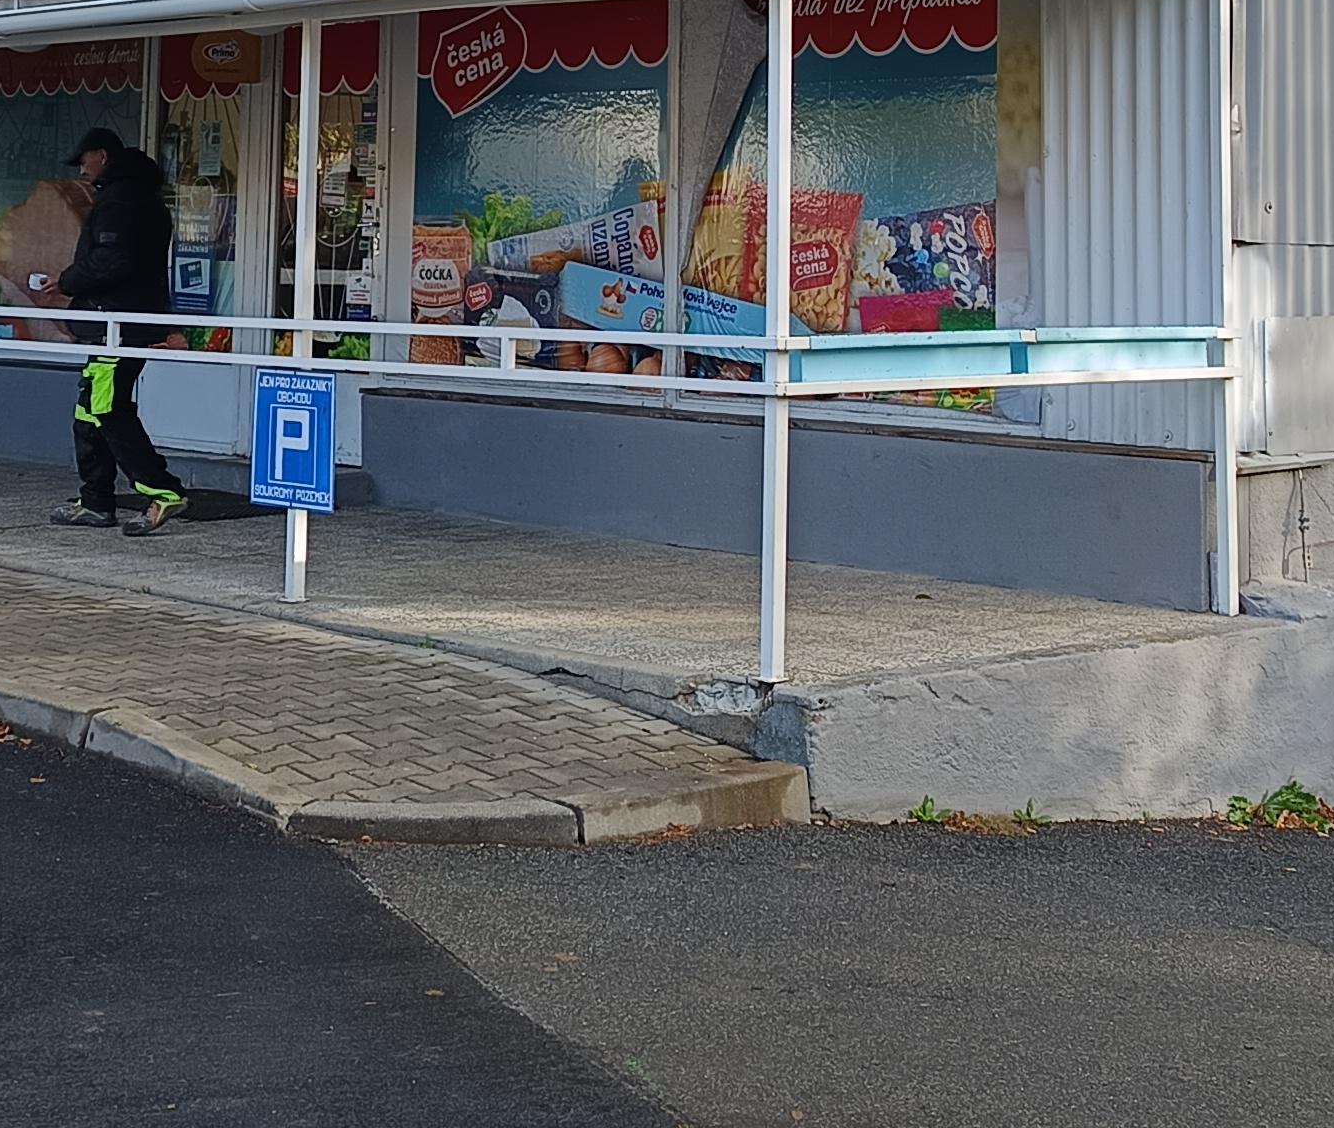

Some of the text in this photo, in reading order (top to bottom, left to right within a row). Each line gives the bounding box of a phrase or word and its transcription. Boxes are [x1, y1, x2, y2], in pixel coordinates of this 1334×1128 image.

[447, 21, 505, 68] česká
[454, 52, 504, 87] cena
[611, 207, 641, 278] Copáne
[792, 244, 830, 264] česká
[943, 212, 974, 311] POPCO
[419, 265, 453, 281] ČOČKA
[795, 263, 828, 277] cena
[259, 375, 274, 388] JEN
[275, 376, 291, 389] PRO
[276, 390, 312, 405] OBCHODU
[274, 408, 310, 481] P
[295, 488, 331, 504] POZEMEK
